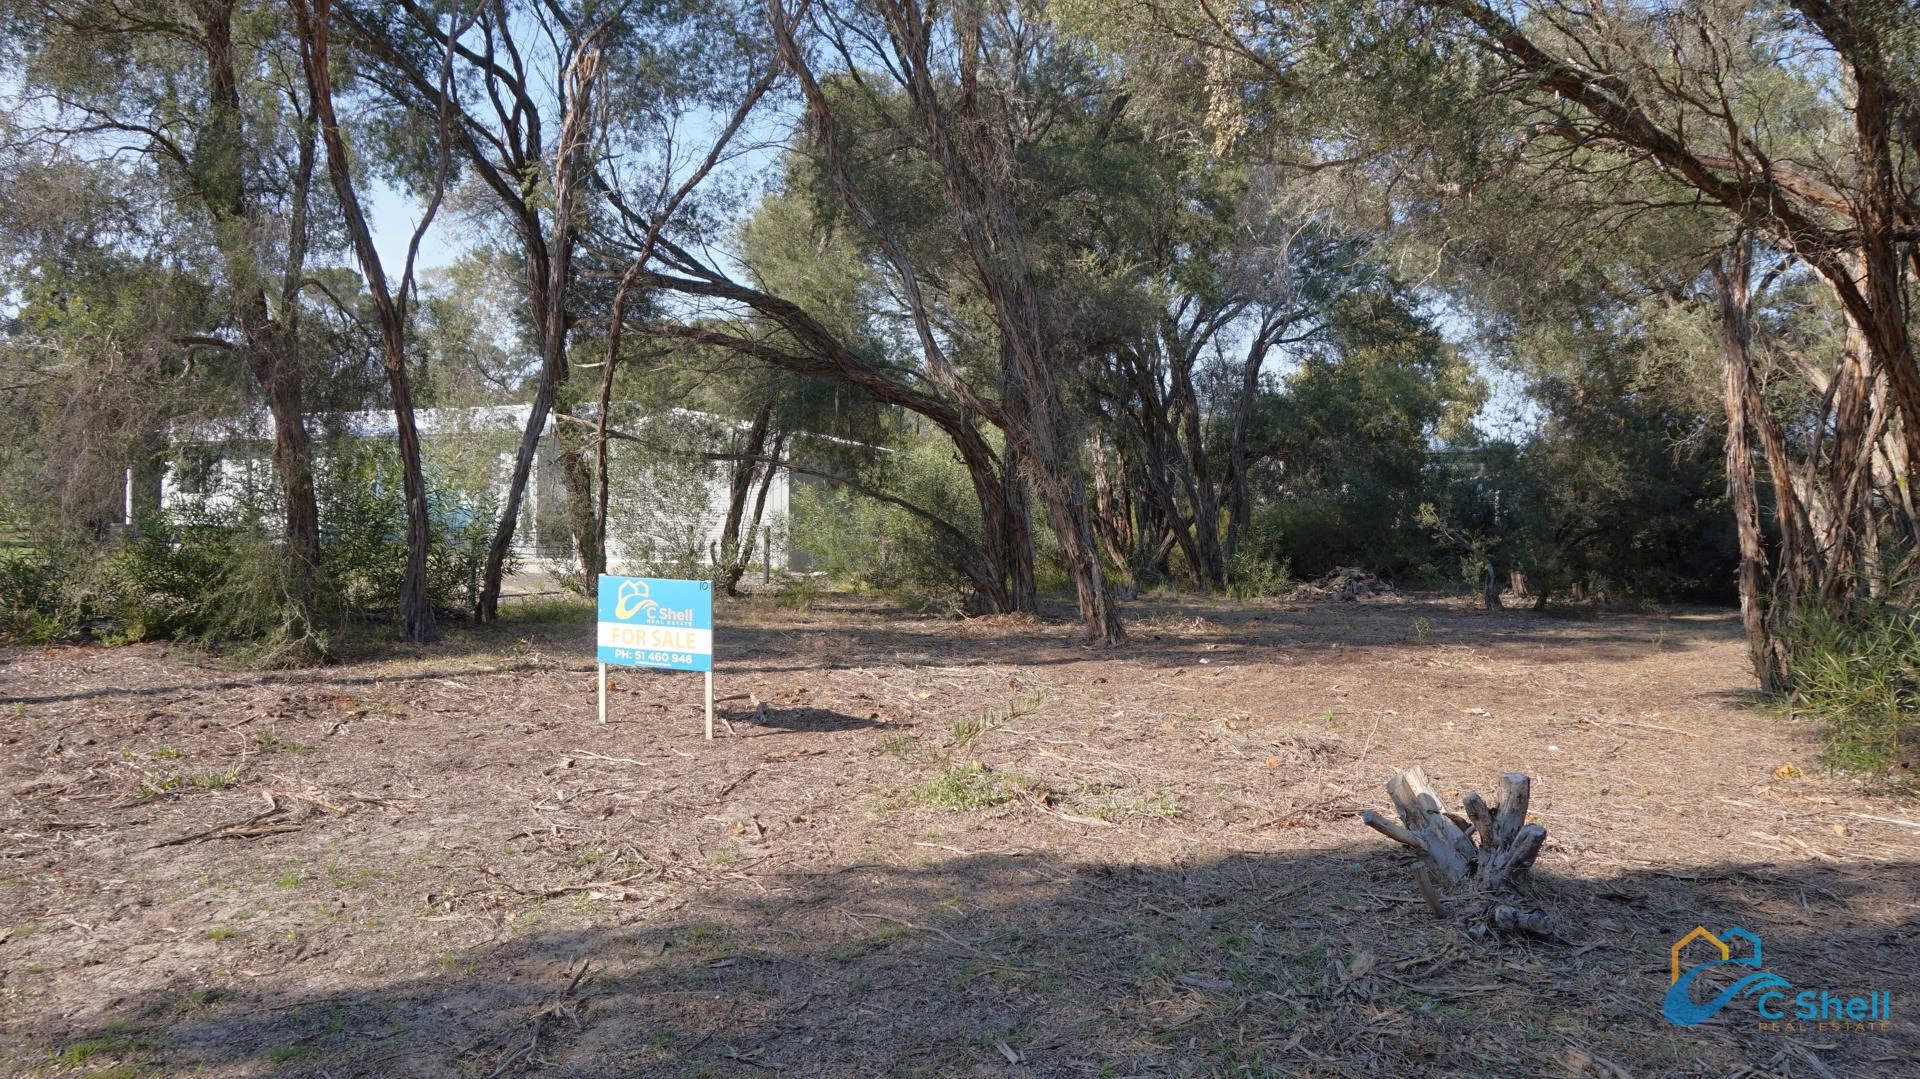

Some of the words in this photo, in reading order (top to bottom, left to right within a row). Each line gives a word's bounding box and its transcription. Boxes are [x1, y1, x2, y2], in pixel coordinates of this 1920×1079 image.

[646, 608, 656, 619] C
[659, 608, 693, 621] Shell
[611, 627, 646, 646] FOR
[652, 630, 696, 650] SALE
[615, 649, 632, 660] PH:
[635, 650, 645, 660] 51
[648, 652, 669, 662] 460
[672, 654, 692, 664] 946
